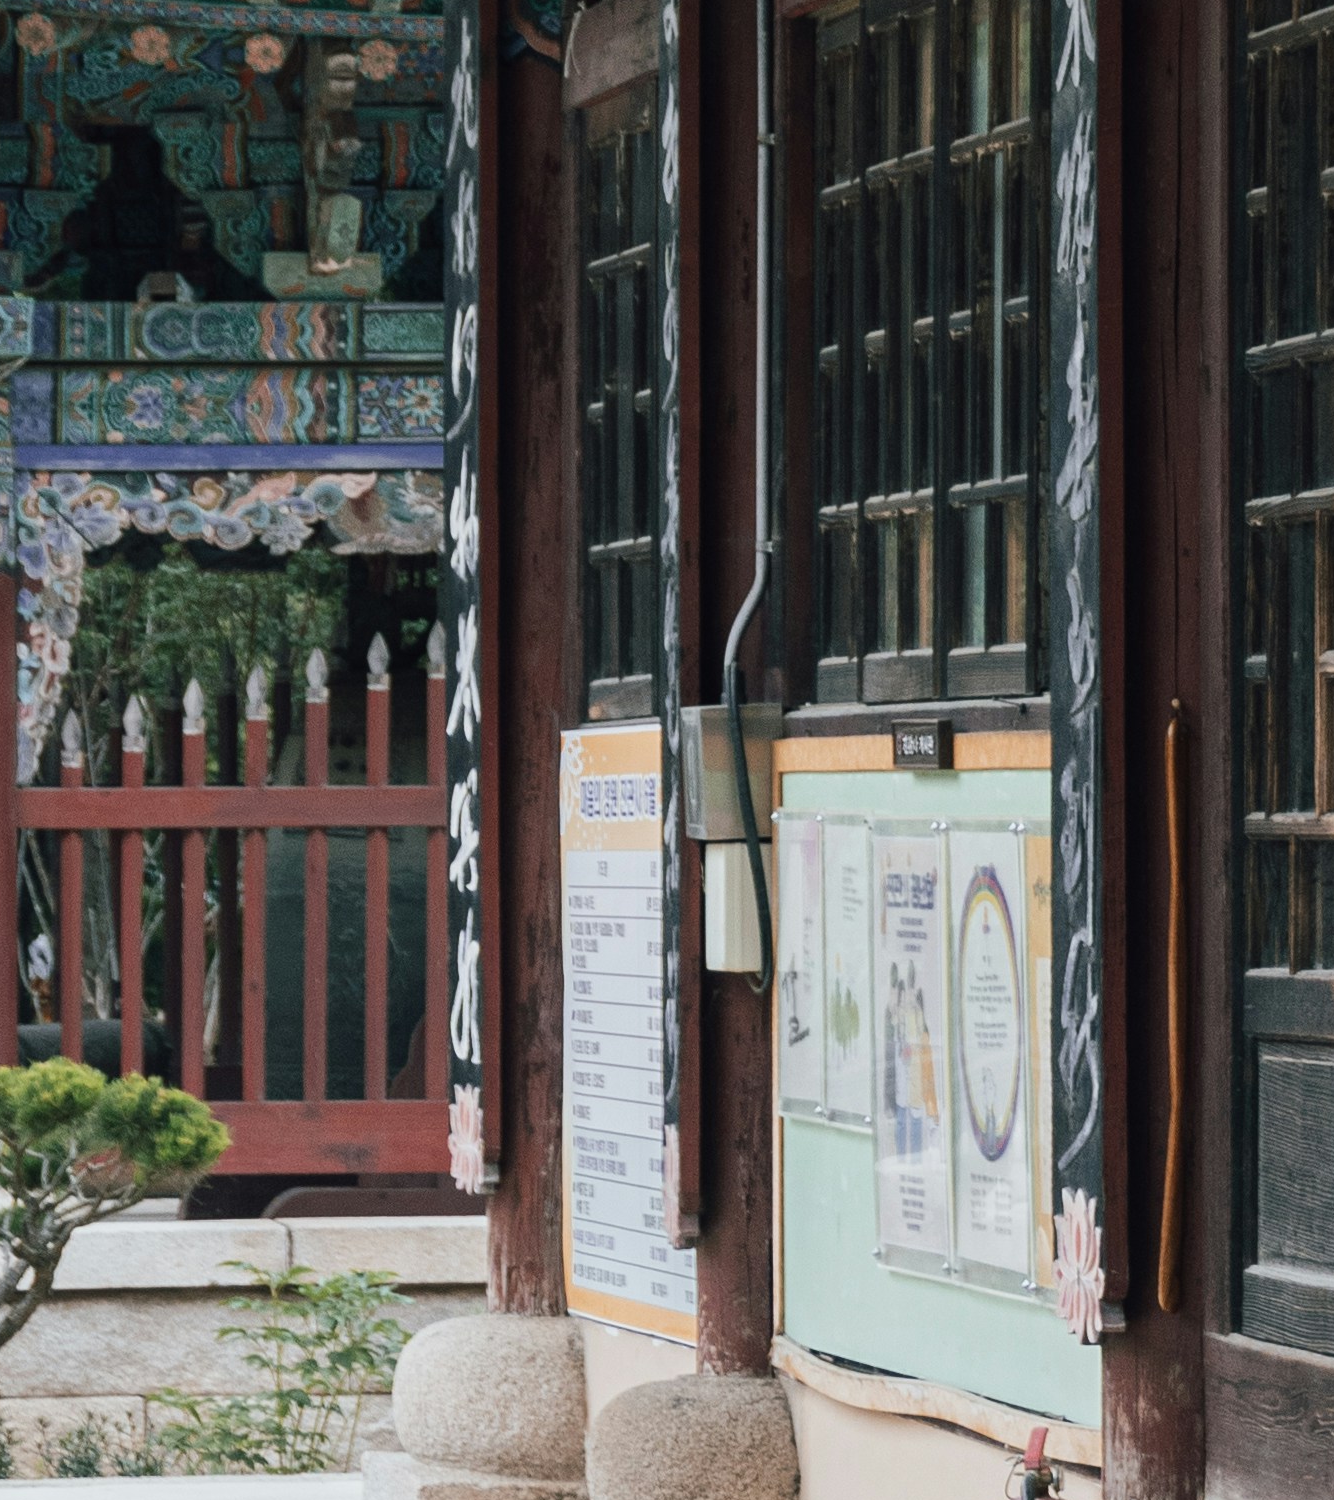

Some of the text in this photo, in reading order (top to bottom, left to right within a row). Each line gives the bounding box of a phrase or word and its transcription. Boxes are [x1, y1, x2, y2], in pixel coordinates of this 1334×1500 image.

[581, 779, 600, 816] 마음의
[604, 779, 617, 816] 정원
[621, 778, 641, 816] 진관사
